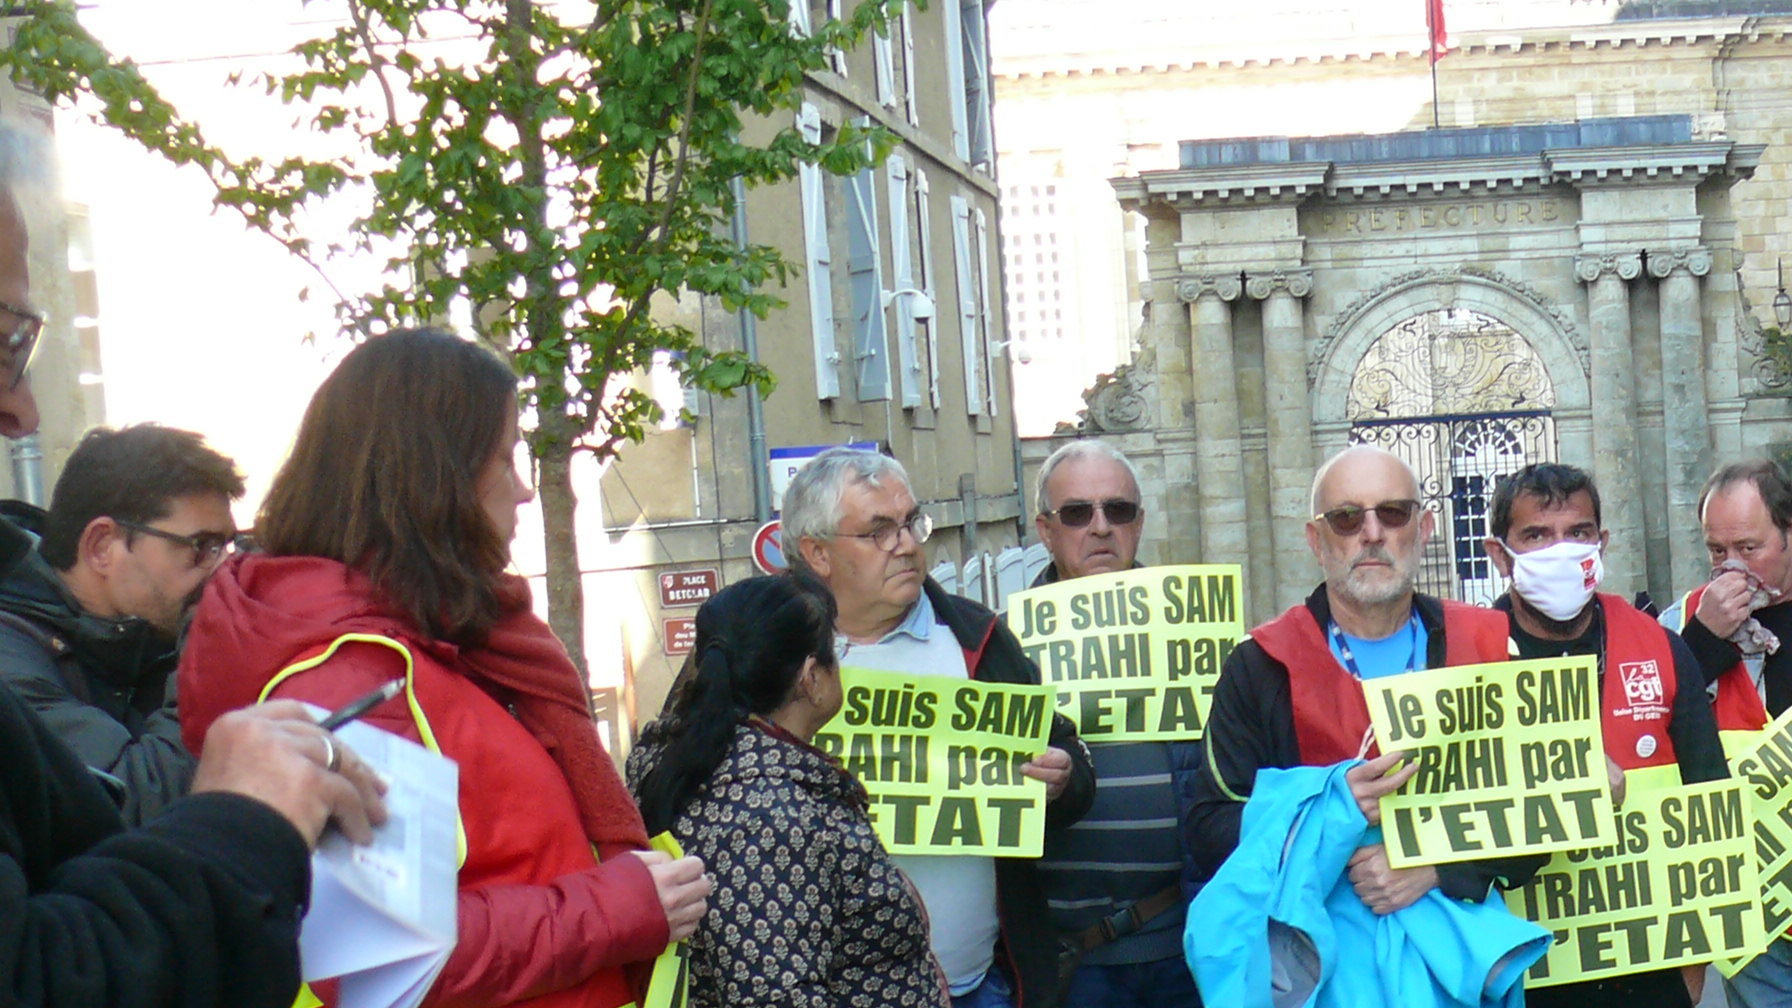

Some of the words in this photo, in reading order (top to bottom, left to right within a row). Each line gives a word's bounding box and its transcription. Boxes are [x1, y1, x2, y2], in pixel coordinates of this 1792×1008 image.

[1321, 200, 1559, 233] PREFECTURE
[1021, 598, 1057, 640] Je
[1070, 581, 1151, 631] suis
[1162, 574, 1236, 625] SAM
[1626, 677, 1662, 701] cgt
[1640, 664, 1656, 674] 32
[844, 683, 938, 729] suis
[951, 687, 1046, 739] SAM
[1056, 686, 1216, 736] 'ETA
[1382, 688, 1427, 741] Je
[1435, 675, 1505, 735] suis
[1516, 667, 1591, 727] SAM
[815, 732, 930, 783] RAHI
[947, 744, 1034, 790] par
[1396, 736, 1508, 796] TRAHI
[1520, 736, 1591, 790] par
[867, 794, 1036, 848] TAT
[1660, 788, 1745, 849] SAM
[1523, 860, 1653, 921] TRAHI
[1667, 853, 1745, 907] par
